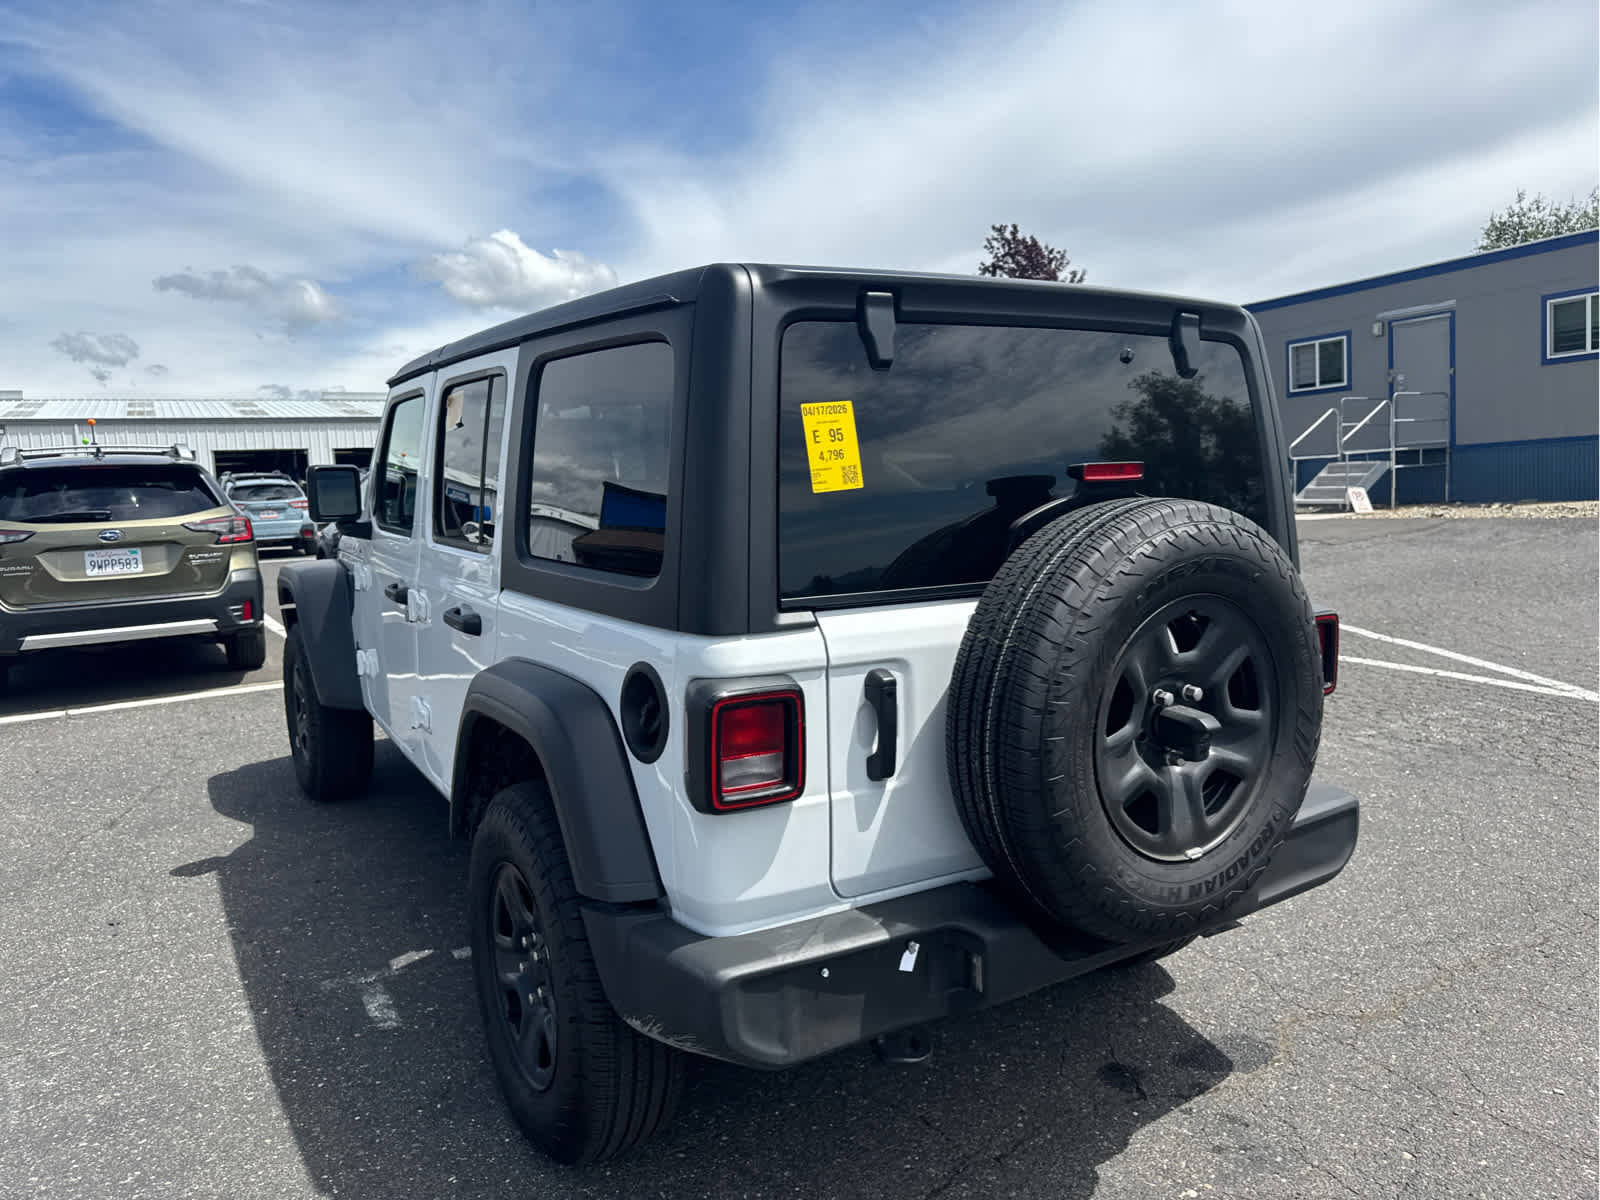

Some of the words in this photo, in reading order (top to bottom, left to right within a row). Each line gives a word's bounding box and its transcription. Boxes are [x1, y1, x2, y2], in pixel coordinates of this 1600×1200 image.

[812, 430, 821, 444] E
[828, 428, 844, 442] 95
[819, 449, 845, 462] 4,796
[89, 557, 139, 572] 9WPP583
